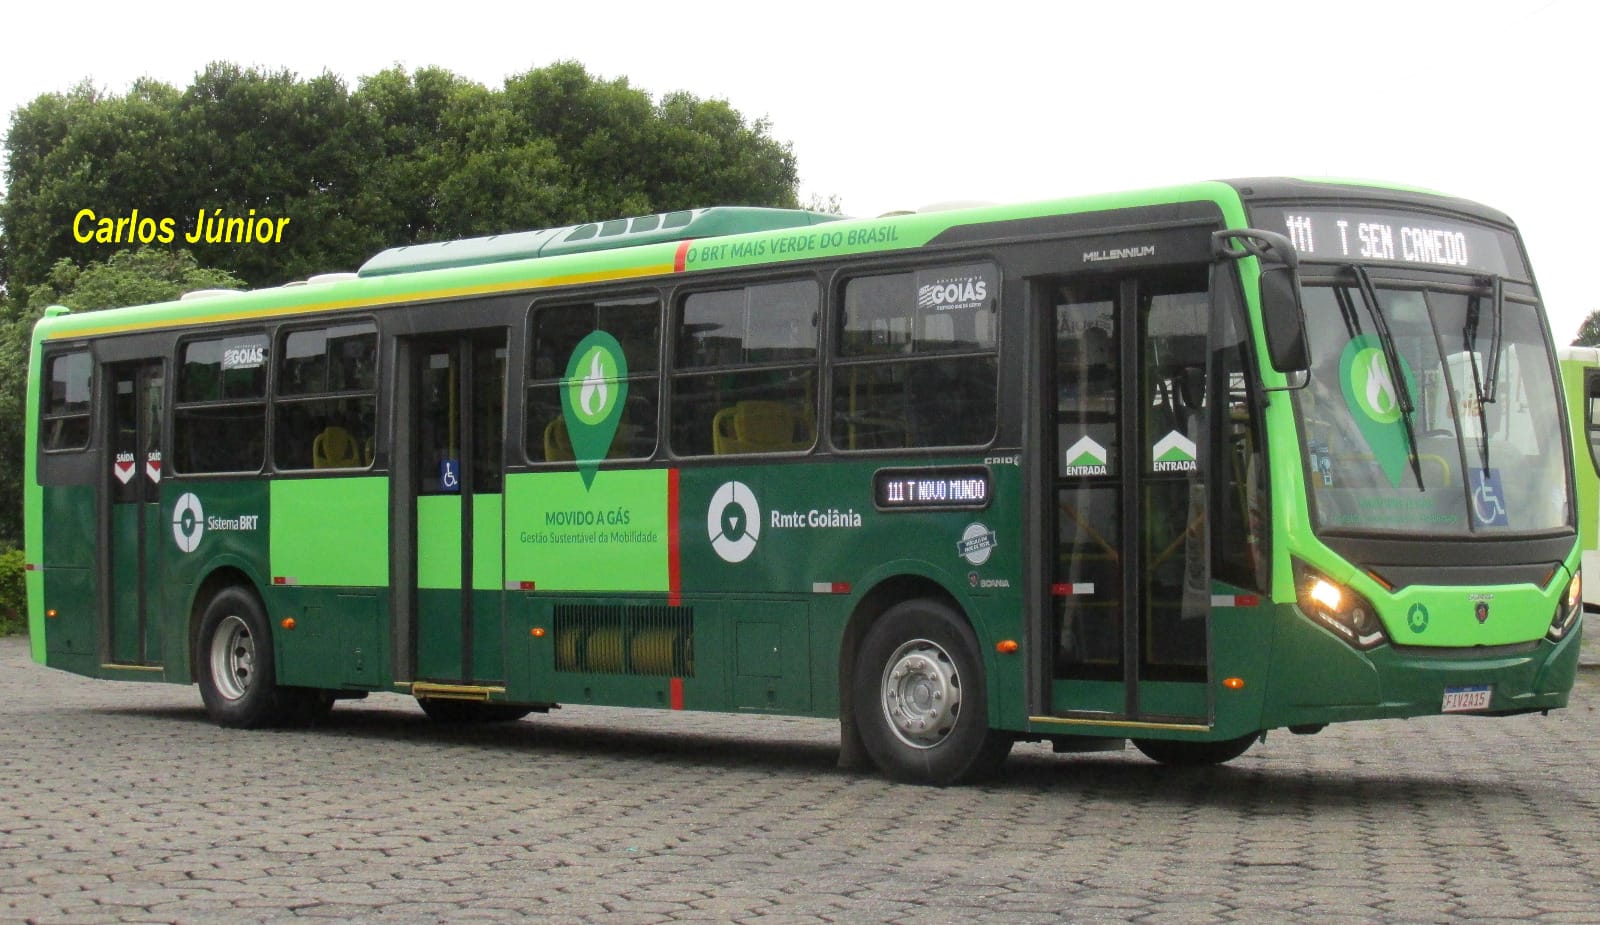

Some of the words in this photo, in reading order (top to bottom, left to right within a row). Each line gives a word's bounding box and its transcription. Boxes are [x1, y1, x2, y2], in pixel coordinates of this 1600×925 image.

[687, 247, 698, 263] O
[701, 243, 729, 262] BRT
[731, 239, 766, 259] MAIS
[770, 233, 817, 255] VERDE
[820, 231, 843, 249] DO
[847, 224, 899, 246] BRASIL
[1286, 215, 1314, 252] 111
[1336, 220, 1349, 256] T
[1083, 245, 1155, 263] MILLENNIUM
[932, 278, 987, 304] GOIÁS
[231, 344, 264, 365] GOIÁS
[116, 450, 135, 462] SAÍDA
[147, 449, 161, 461] SAÍD
[1066, 465, 1107, 476] ENTRADA
[1152, 461, 1198, 472] ENTRADA
[888, 481, 904, 501] 111
[907, 481, 916, 501] T
[918, 480, 947, 500] NOVO
[949, 479, 985, 500] MUNDO
[207, 515, 239, 530] Sistema
[239, 514, 259, 530] BRT
[545, 511, 594, 526] MOVIDO
[596, 511, 605, 526] A
[606, 506, 630, 525] GÁS
[771, 509, 806, 528] Rmtc
[807, 508, 862, 528] Goiânia
[520, 531, 548, 544] Gestão
[550, 530, 597, 544] Sustentável
[599, 530, 609, 543] da
[610, 529, 657, 543] Mobilidade
